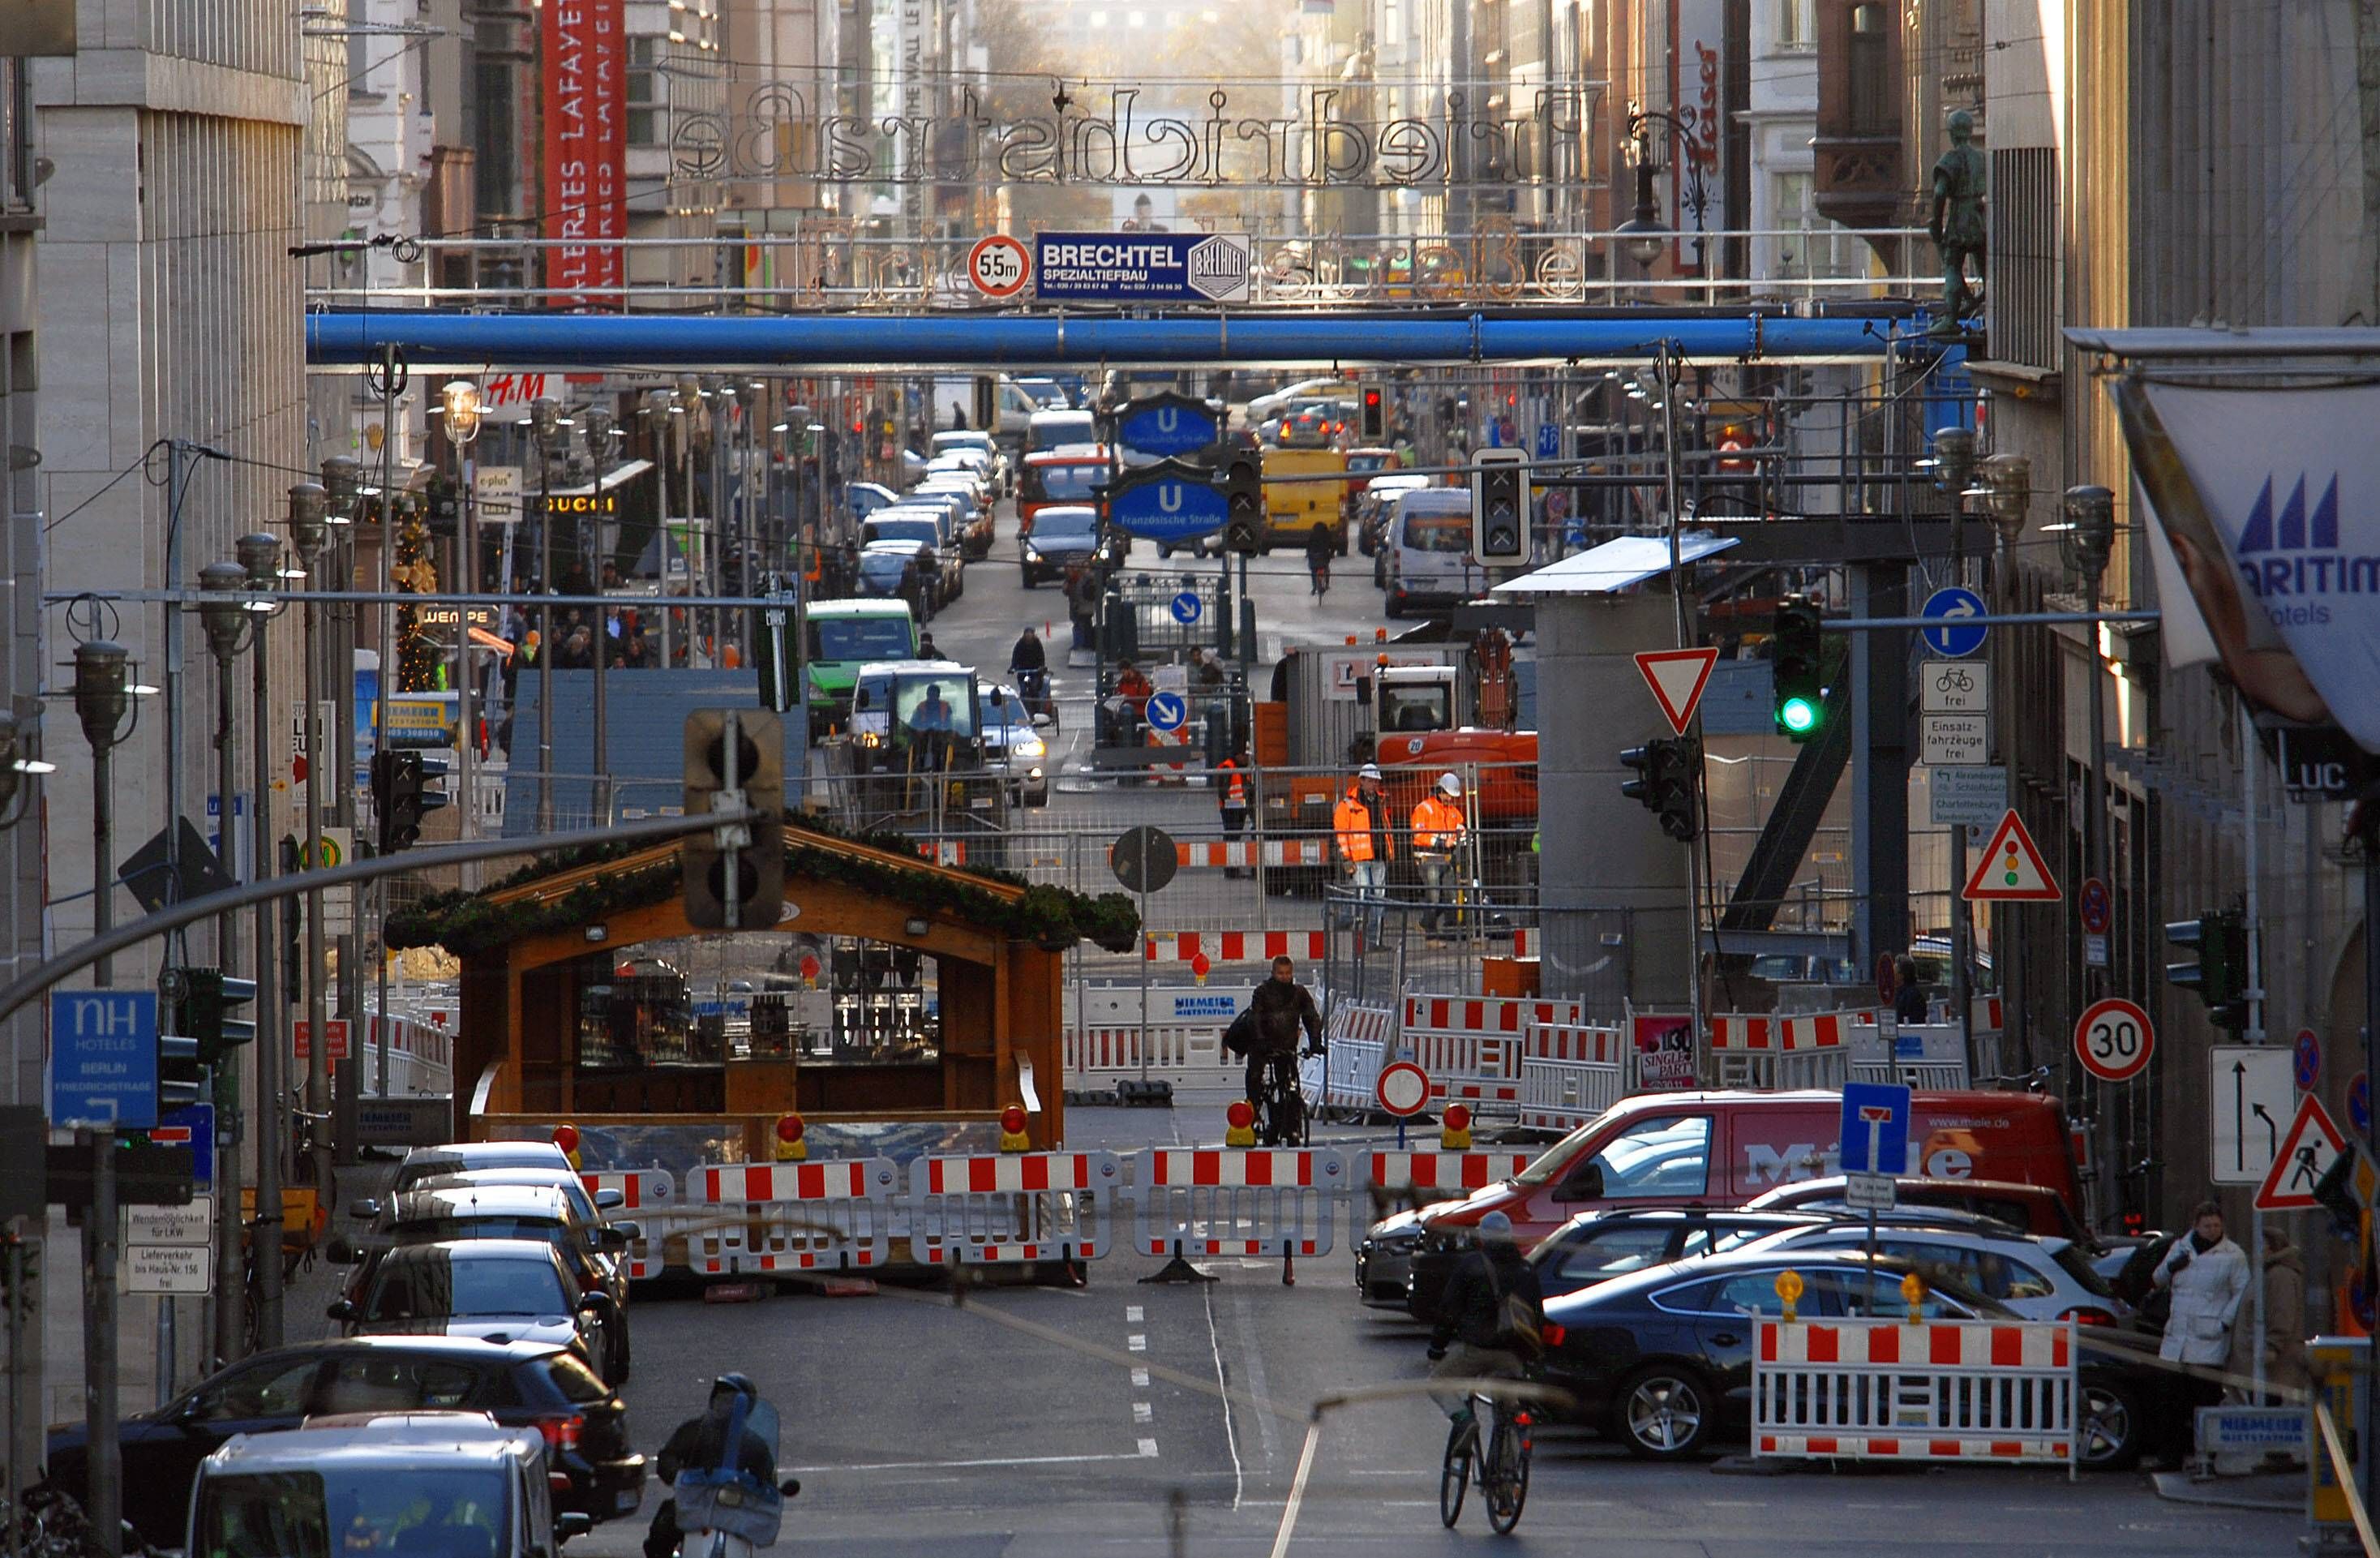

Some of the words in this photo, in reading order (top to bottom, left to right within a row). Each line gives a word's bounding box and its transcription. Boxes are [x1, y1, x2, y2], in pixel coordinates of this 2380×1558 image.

[905, 35, 920, 83] WALL
[558, 0, 584, 140] LAFAYE
[1043, 244, 1182, 268] BRECHTEL
[1194, 237, 1242, 277] BRECHTEL
[1043, 268, 1147, 281] SPEZIALTIEFBAU
[487, 373, 545, 406] H&M
[1158, 408, 1177, 432] U
[1160, 485, 1182, 513] U
[1121, 513, 1186, 526] Französische
[1189, 513, 1221, 525] Straße
[2237, 555, 2380, 597] ARITIM
[2266, 603, 2331, 627] otels
[1945, 694, 1966, 706] frei
[1932, 721, 1978, 732] Einsatz-
[1410, 740, 1422, 752] 20
[1927, 735, 1983, 747] fahrzeuge
[1946, 749, 1965, 758] frei
[1174, 998, 1234, 1007] NIEMEIER
[76, 1038, 137, 1052] HOTELES
[2093, 1022, 2137, 1058] 30
[81, 1062, 127, 1074] BERLIN
[1659, 1062, 1694, 1079] PARTY
[1928, 1116, 2009, 1129] www.miele.de
[1744, 1140, 1974, 1184] Mile
[132, 1213, 204, 1225] Wendemöglichkeit
[152, 1227, 164, 1237] für
[165, 1227, 184, 1238] LKW
[141, 1250, 193, 1260] Lieferverkehr
[135, 1265, 147, 1273] bis
[159, 1278, 173, 1289] frei
